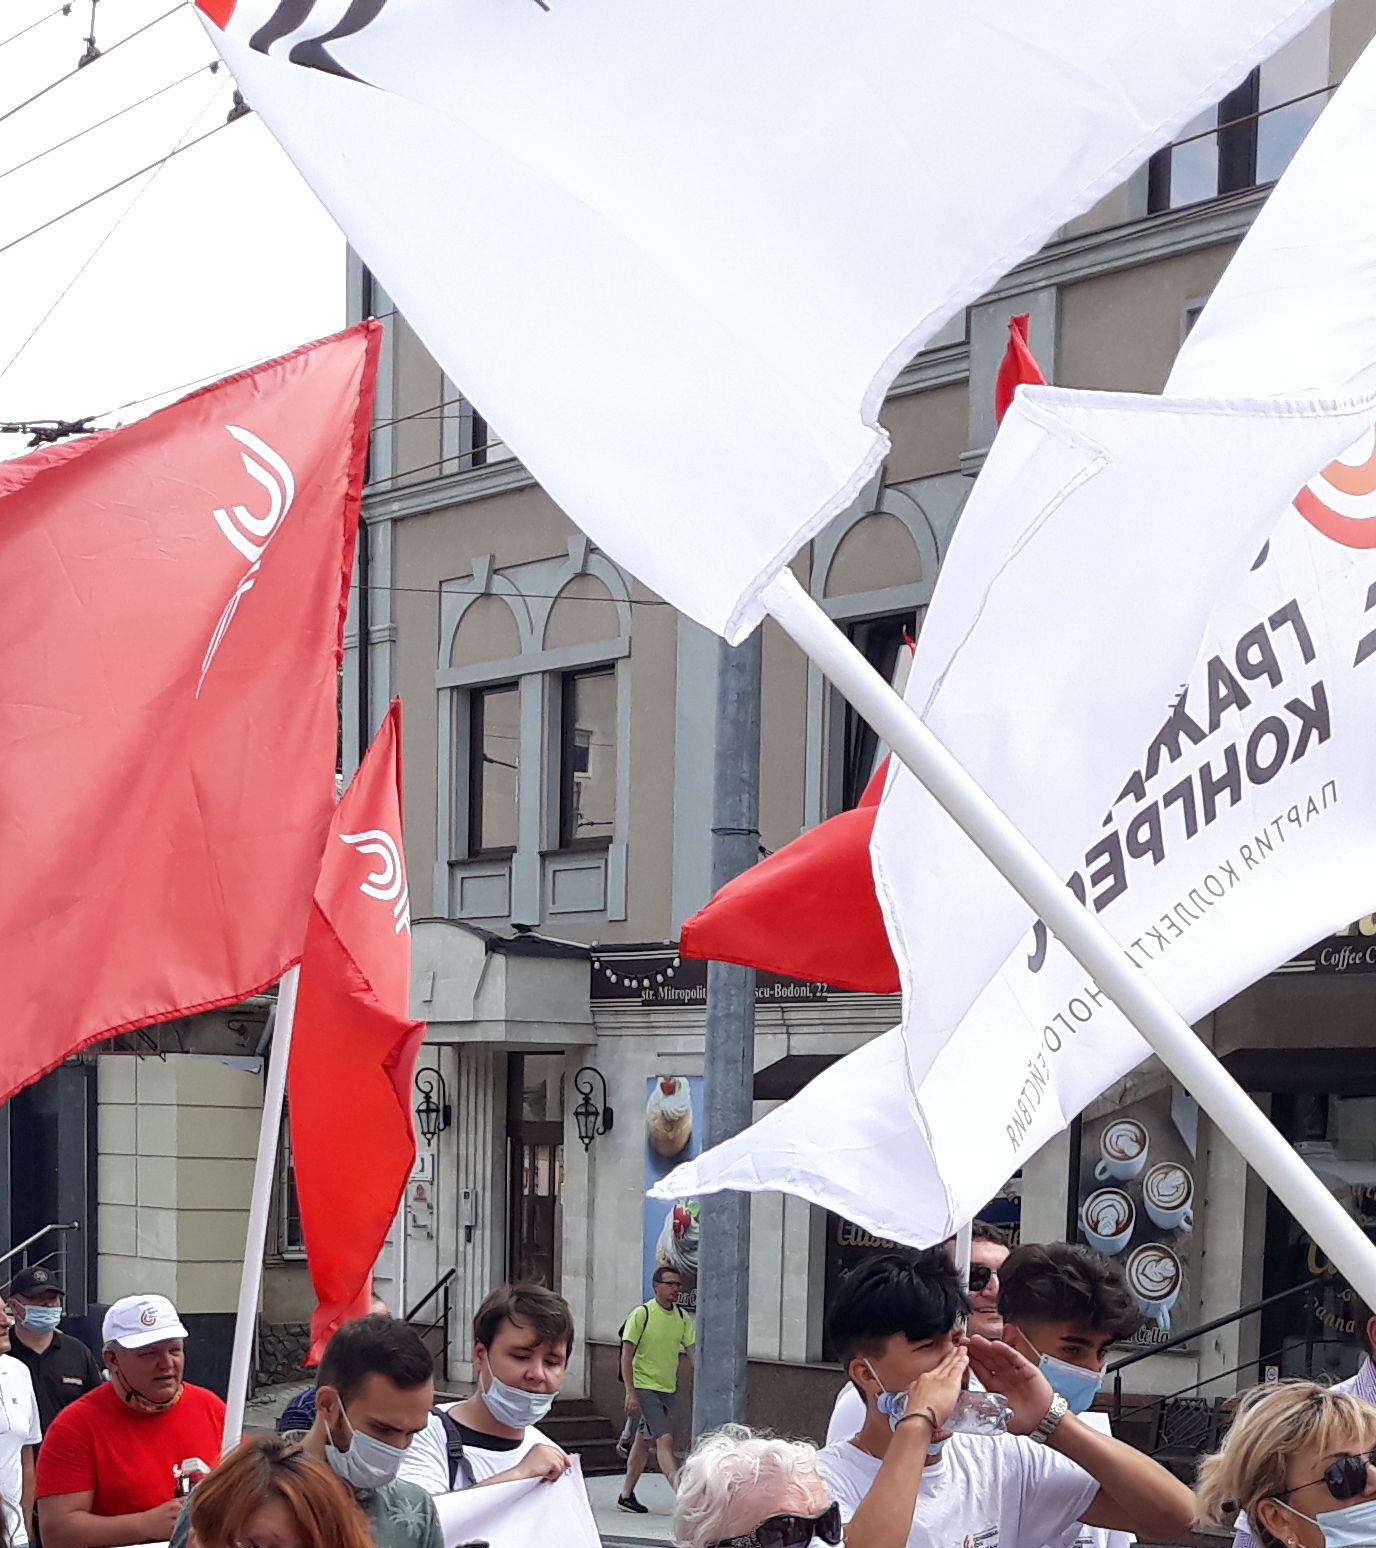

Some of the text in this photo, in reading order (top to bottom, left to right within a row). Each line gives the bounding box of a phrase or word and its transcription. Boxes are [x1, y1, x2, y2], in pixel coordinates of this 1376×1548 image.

[1320, 946, 1362, 971] Coffee
[641, 982, 828, 1003] str. Mitropolit scu-Bodoni, 22
